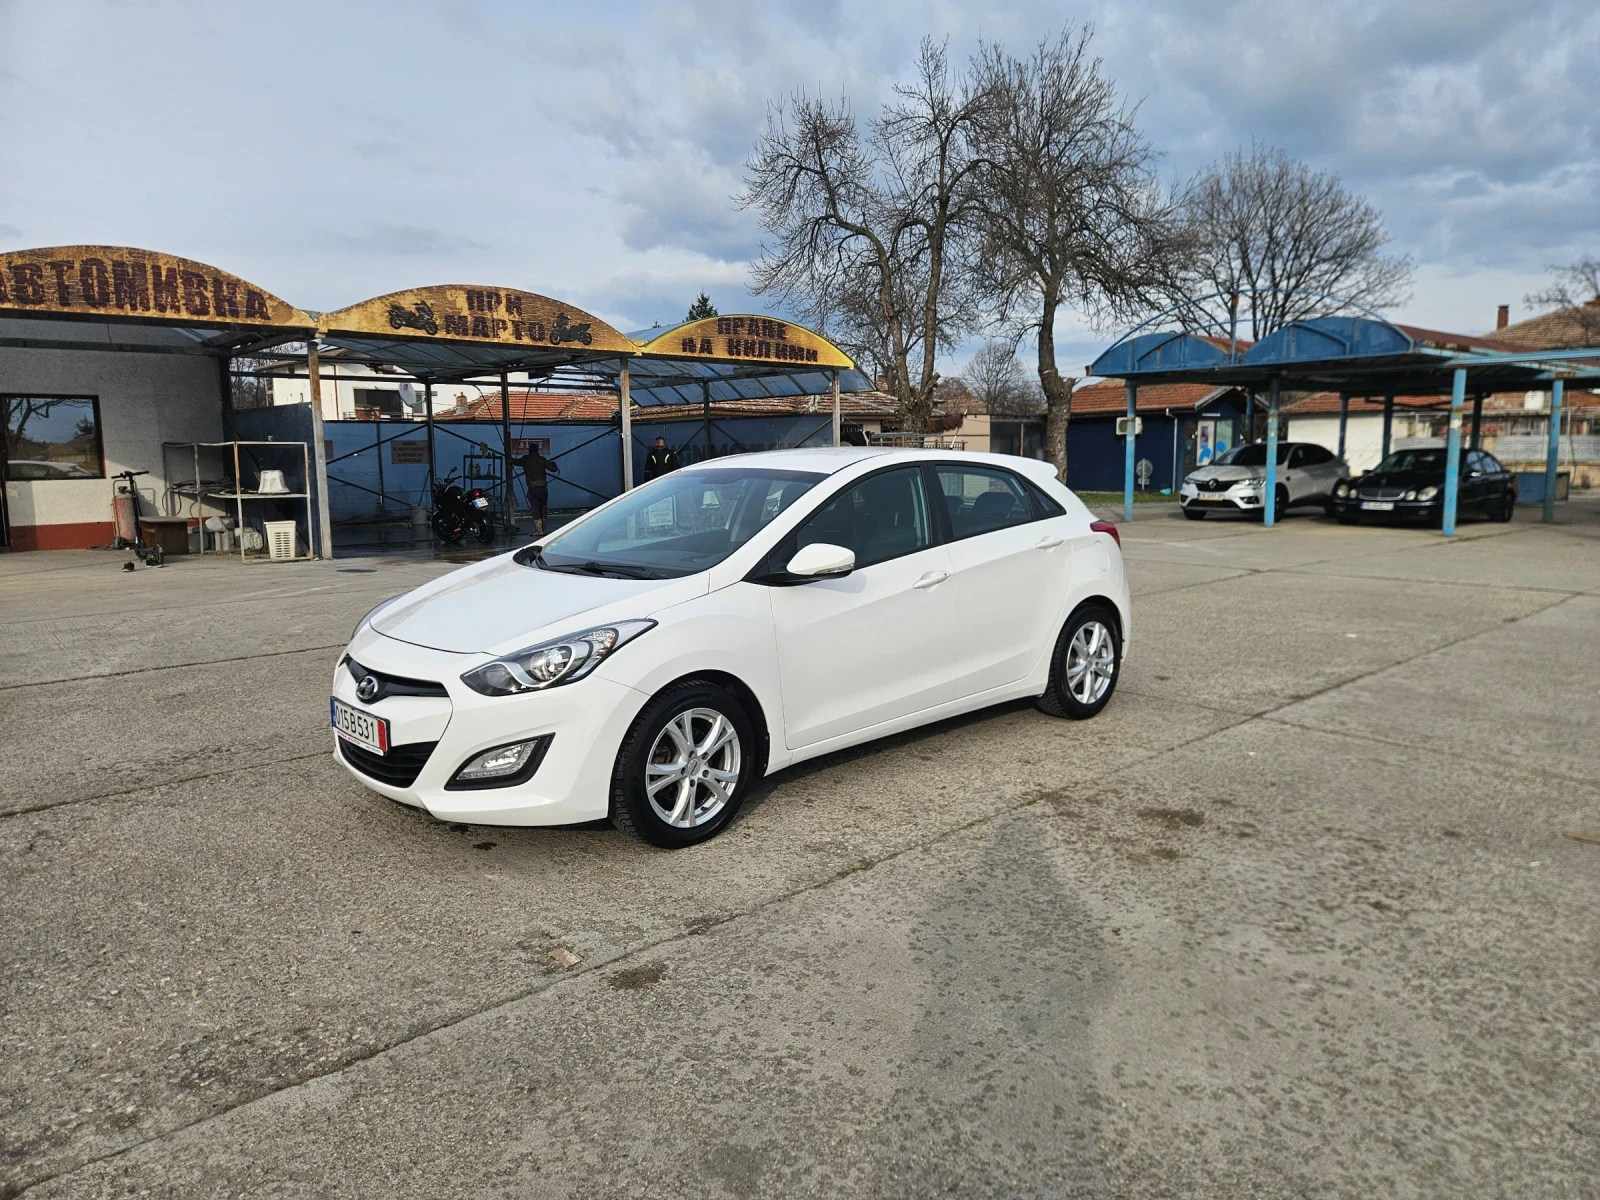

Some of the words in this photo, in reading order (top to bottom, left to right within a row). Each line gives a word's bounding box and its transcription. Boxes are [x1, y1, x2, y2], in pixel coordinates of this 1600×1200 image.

[466, 289, 523, 316] ПРИ
[444, 314, 546, 342] МАРТО
[717, 317, 787, 340] ПРАНЕ
[681, 337, 713, 354] НА
[727, 338, 818, 362] КИЛИМИ
